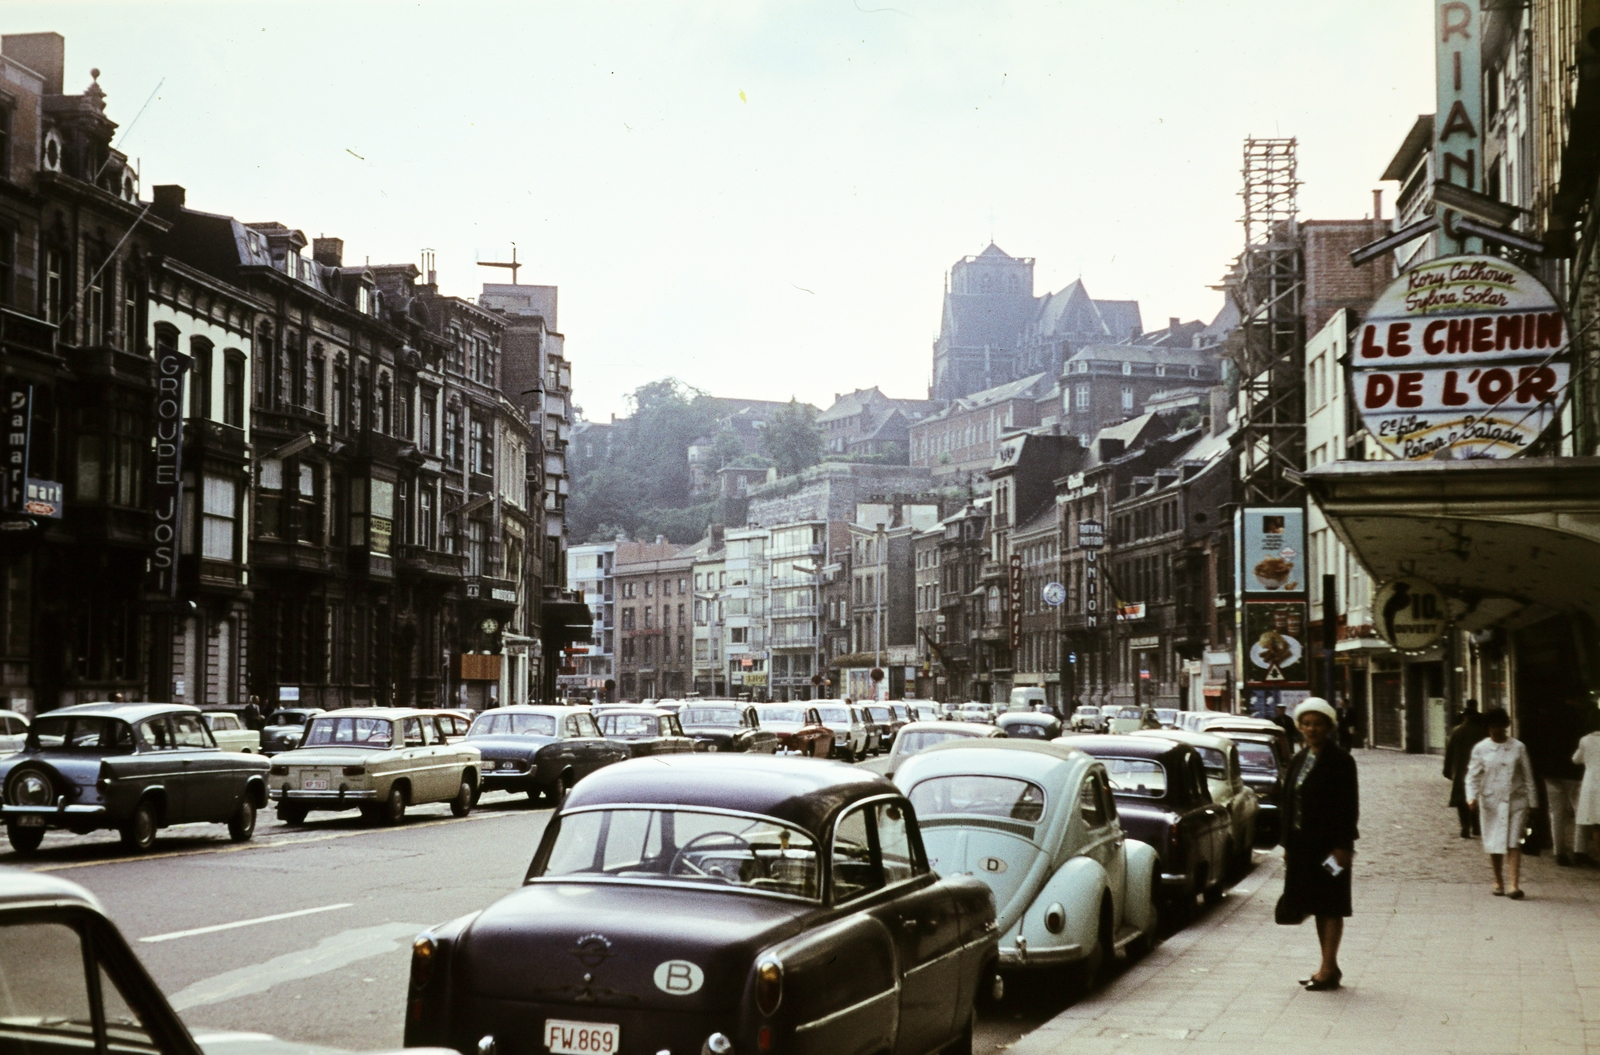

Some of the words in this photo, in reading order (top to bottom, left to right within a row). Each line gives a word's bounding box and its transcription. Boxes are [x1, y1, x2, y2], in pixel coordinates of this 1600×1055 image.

[1407, 269, 1445, 292] Rory
[1449, 260, 1516, 284] Calhoun
[1462, 284, 1508, 306] Solar
[1361, 322, 1413, 358] LE
[1422, 312, 1564, 355] CHEMIN
[1364, 372, 1425, 409] DE
[1441, 366, 1559, 406] L'OR
[156, 355, 179, 485] GROUPE
[1463, 415, 1528, 447] Bataan
[9, 391, 26, 502] Damart
[154, 496, 175, 590] JOSI
[1079, 524, 1102, 534] ROYAL
[1079, 536, 1104, 546] MOTOR
[1087, 550, 1097, 627] UNION
[987, 858, 998, 871] D
[666, 963, 693, 991] B
